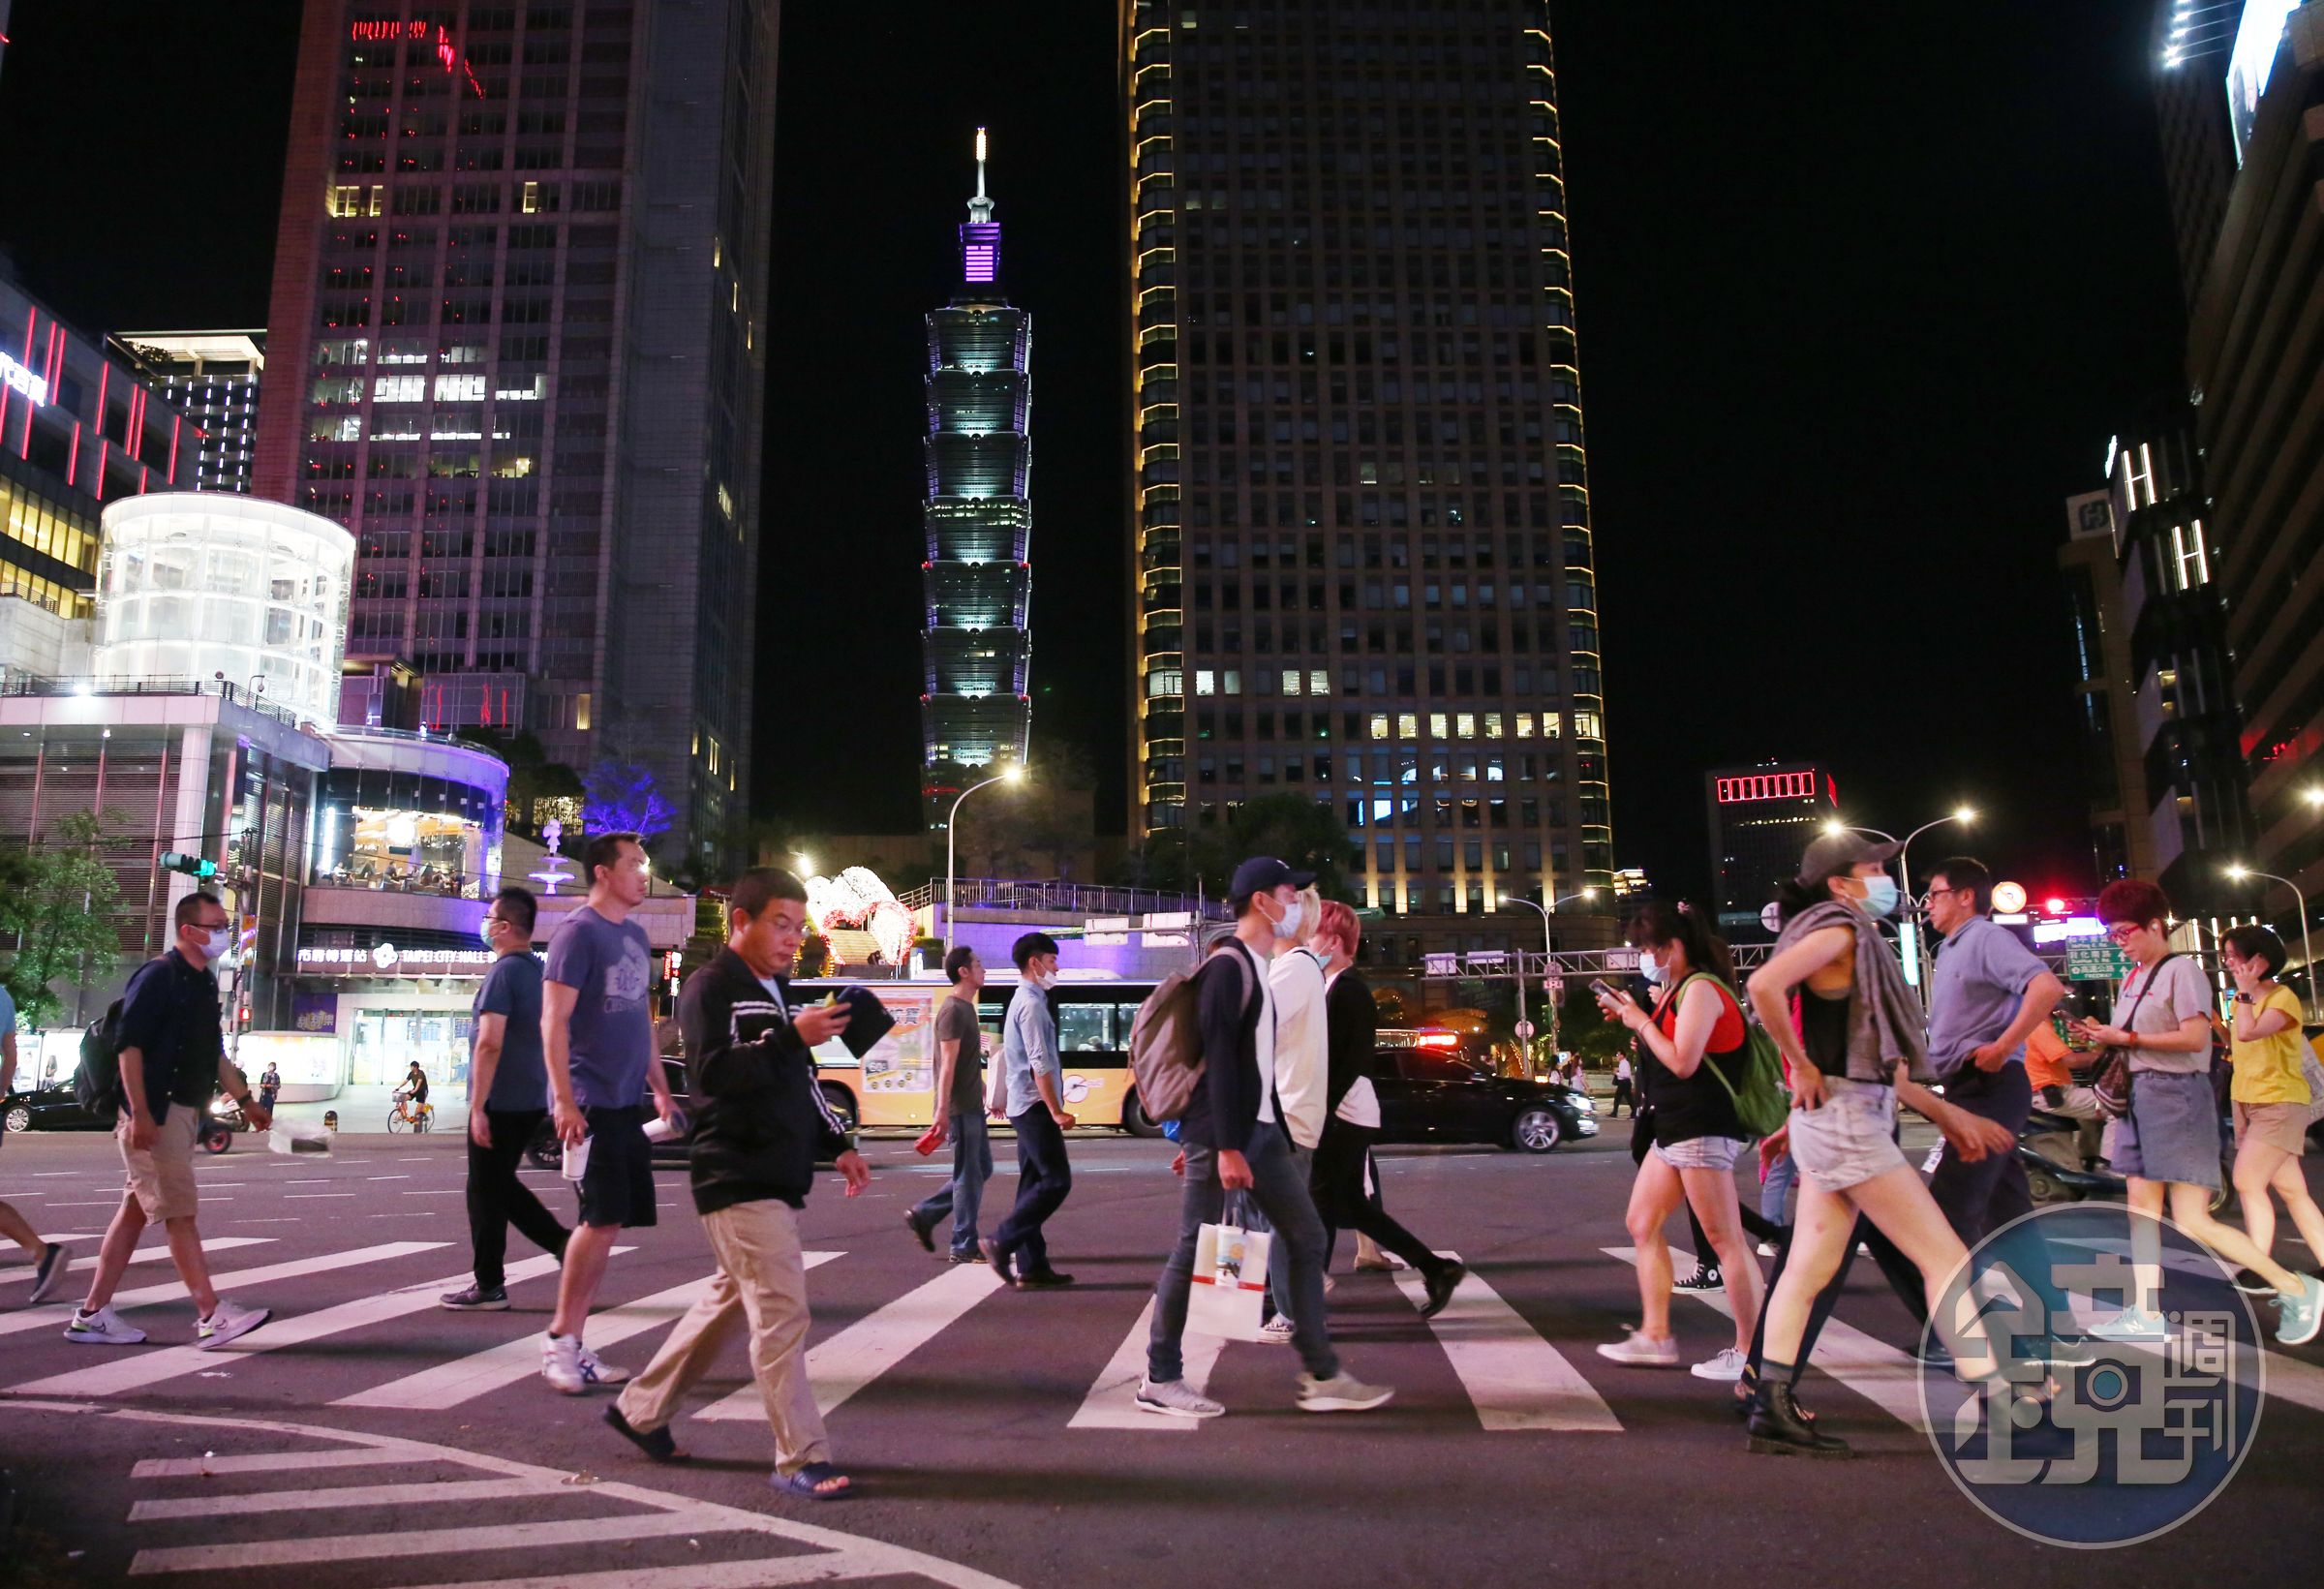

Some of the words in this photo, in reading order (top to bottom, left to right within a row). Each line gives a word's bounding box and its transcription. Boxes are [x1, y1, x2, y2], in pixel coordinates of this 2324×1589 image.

[403, 950, 433, 963] TAIPEI
[436, 951, 456, 963] CITY
[459, 951, 484, 963] HALL
